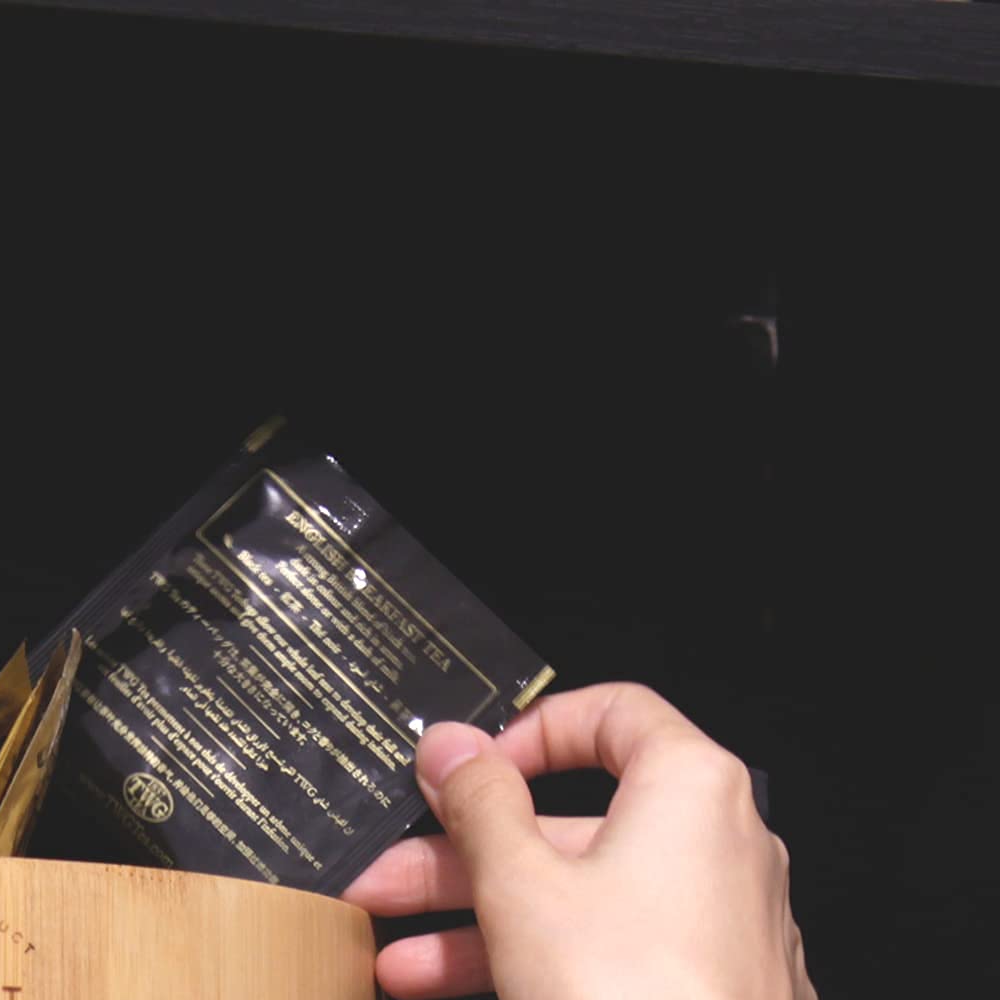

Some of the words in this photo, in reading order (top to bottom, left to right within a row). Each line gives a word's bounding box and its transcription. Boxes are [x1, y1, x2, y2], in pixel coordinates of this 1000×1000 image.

[286, 509, 349, 571] ENGLISH
[345, 566, 425, 644] BEAKFAST
[422, 641, 453, 671] TEA
[124, 776, 170, 819] TWG
[293, 774, 316, 797] TWG
[288, 836, 315, 862] unique
